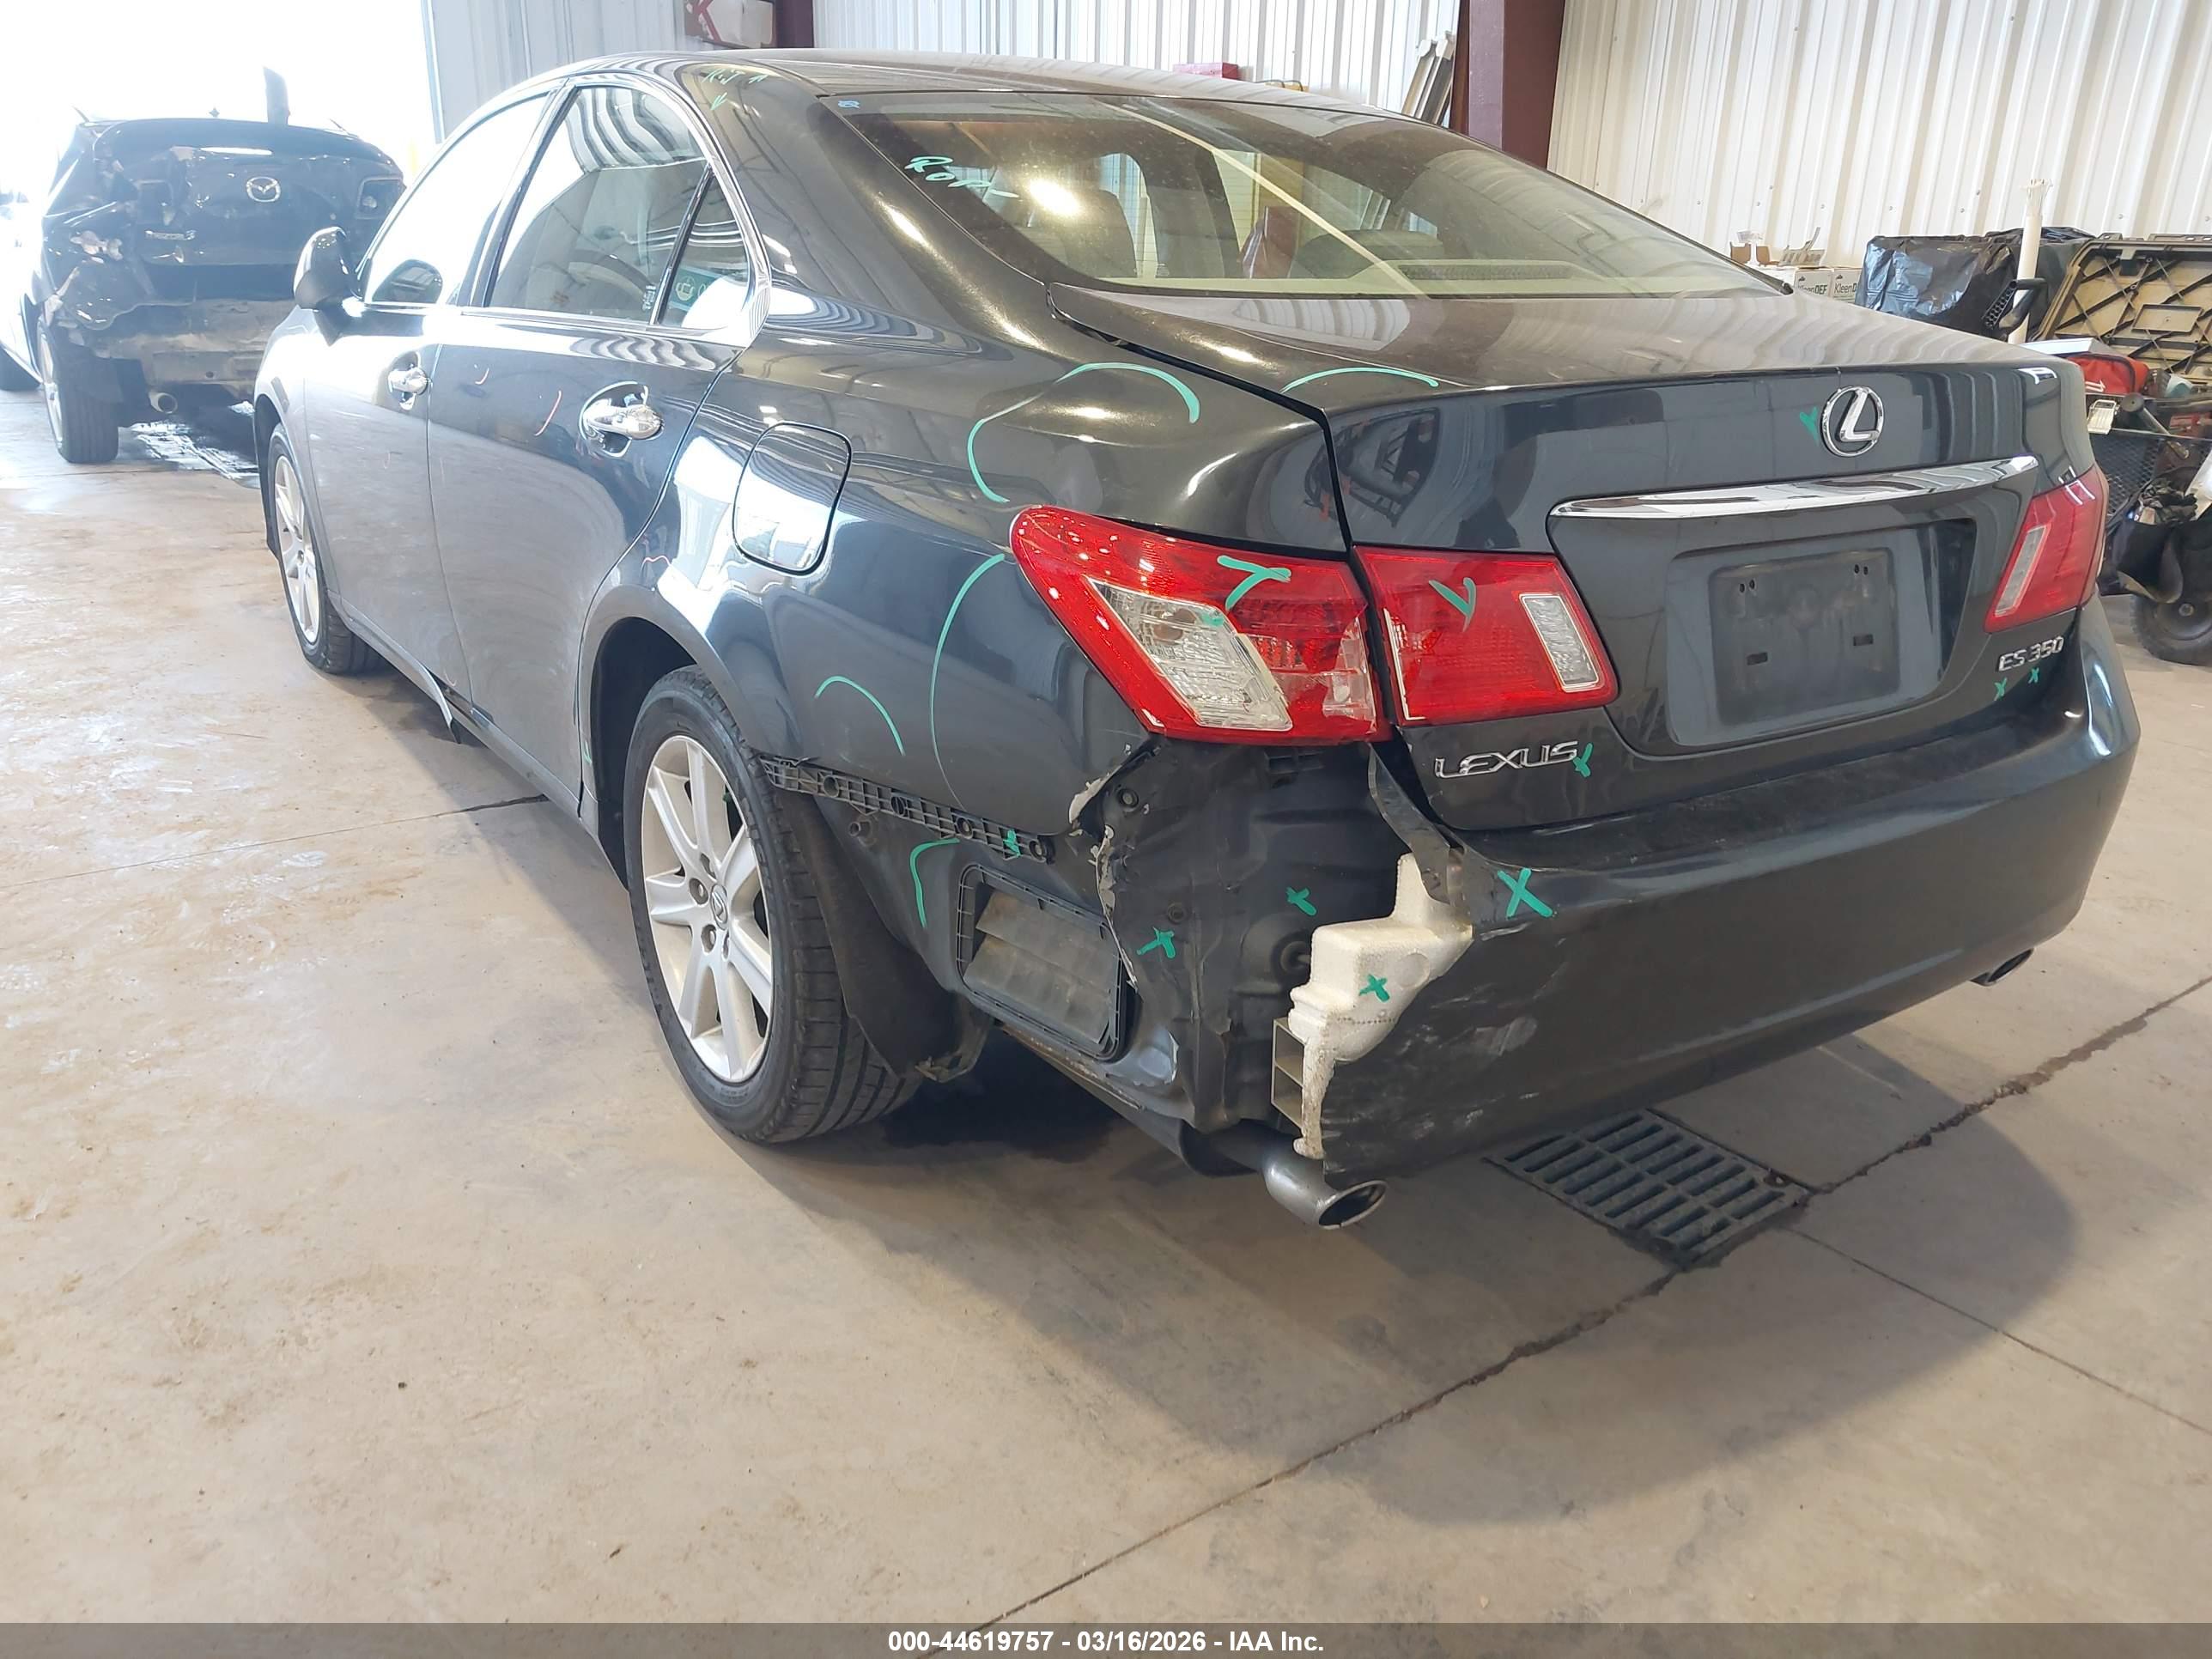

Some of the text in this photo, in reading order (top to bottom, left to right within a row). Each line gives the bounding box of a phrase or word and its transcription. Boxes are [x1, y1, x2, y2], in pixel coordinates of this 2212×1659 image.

[1999, 636, 2064, 671] ES 350
[1435, 740, 1578, 779] LEXUS
